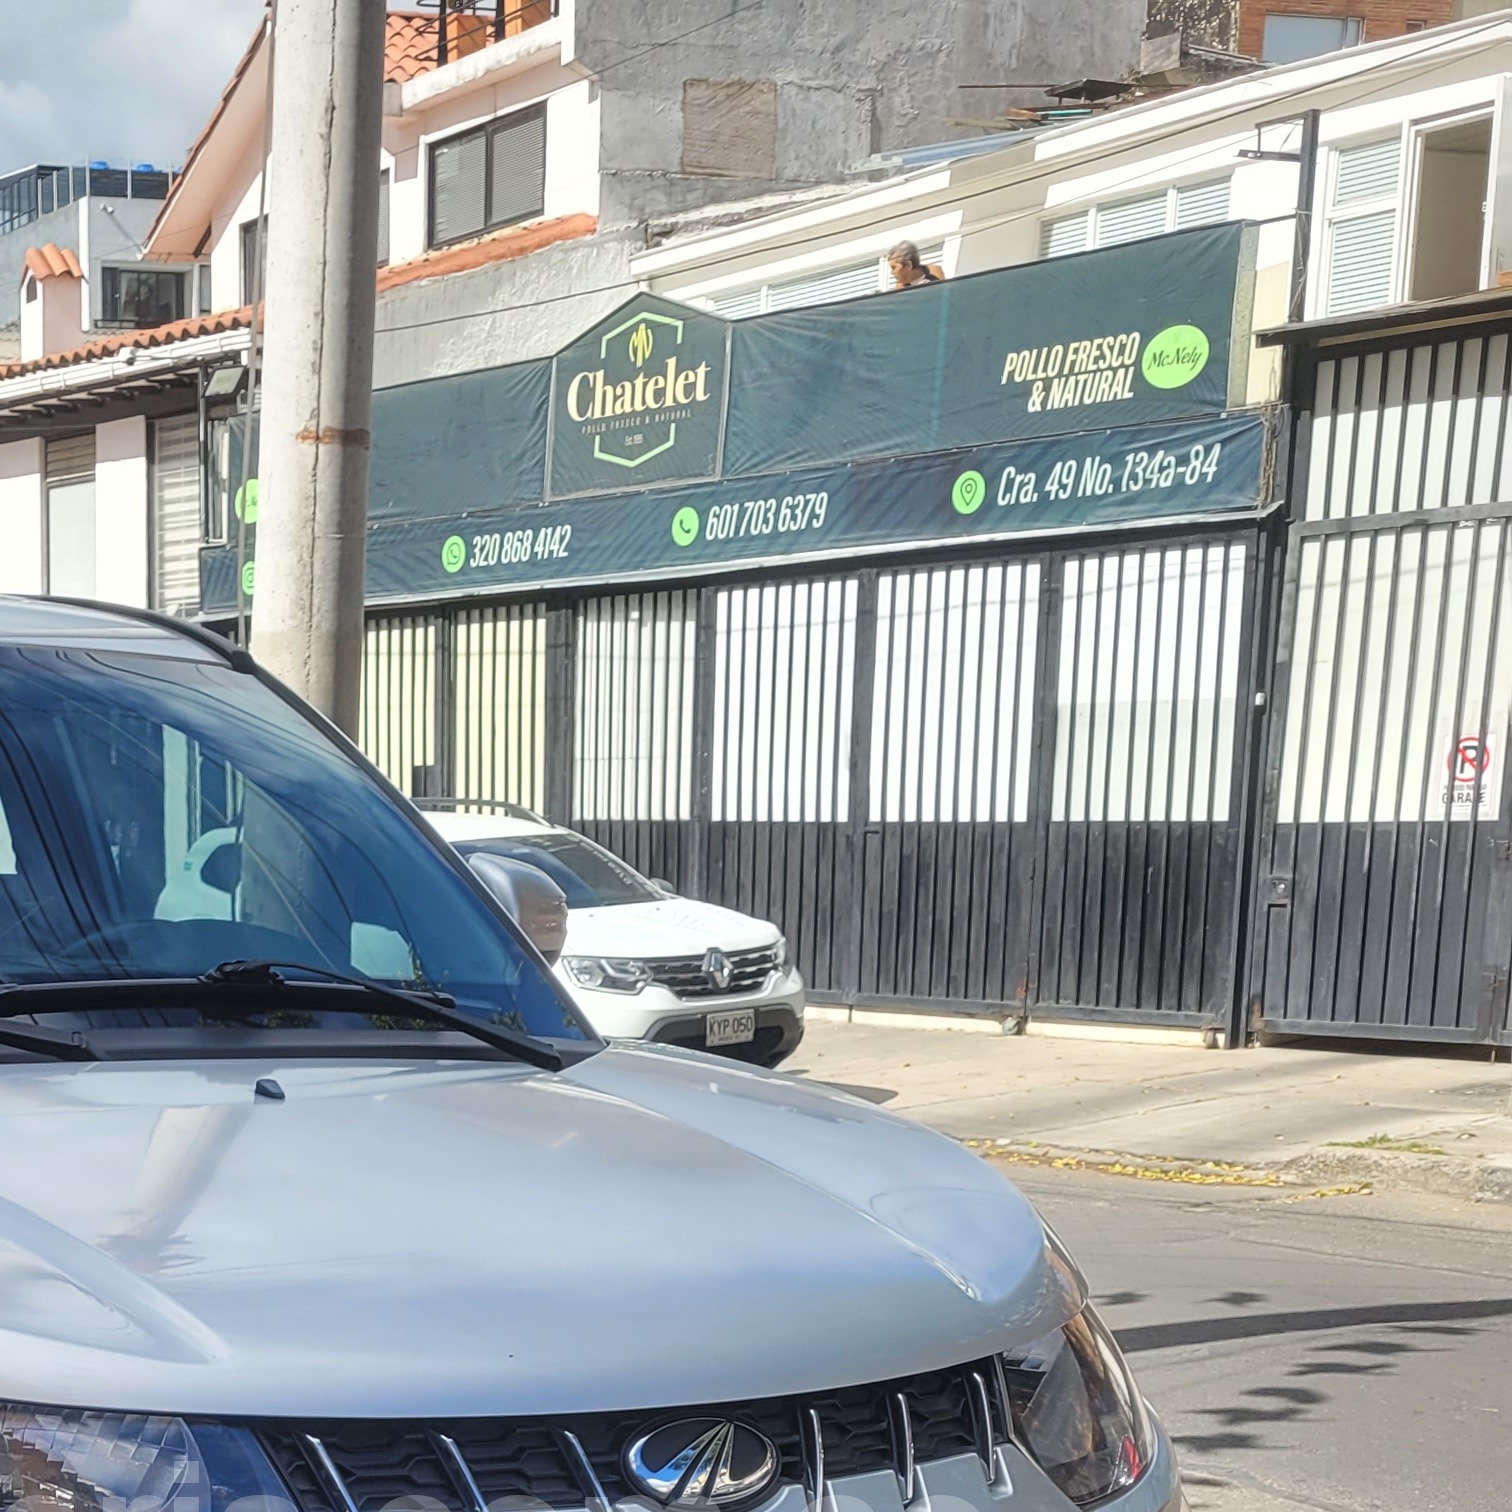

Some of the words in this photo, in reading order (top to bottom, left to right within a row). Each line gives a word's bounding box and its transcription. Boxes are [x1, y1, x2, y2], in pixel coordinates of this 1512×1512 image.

[1000, 344, 1064, 385] POLLO
[1063, 331, 1141, 375] FRESCO
[567, 356, 712, 422] Chatelet
[1027, 380, 1046, 413] &
[1046, 366, 1135, 411] NATURAL
[996, 466, 1039, 507] Cra.
[1044, 459, 1077, 501] 49
[1077, 455, 1114, 498] No.
[1120, 442, 1222, 493] 134a-84
[705, 503, 740, 541] 601
[739, 498, 777, 538] 703
[777, 491, 828, 533] 6379
[470, 533, 501, 568] 320
[501, 529, 534, 565] 868
[534, 524, 572, 560] 4142
[709, 1018, 730, 1037] KYP
[732, 1016, 753, 1034] 050
